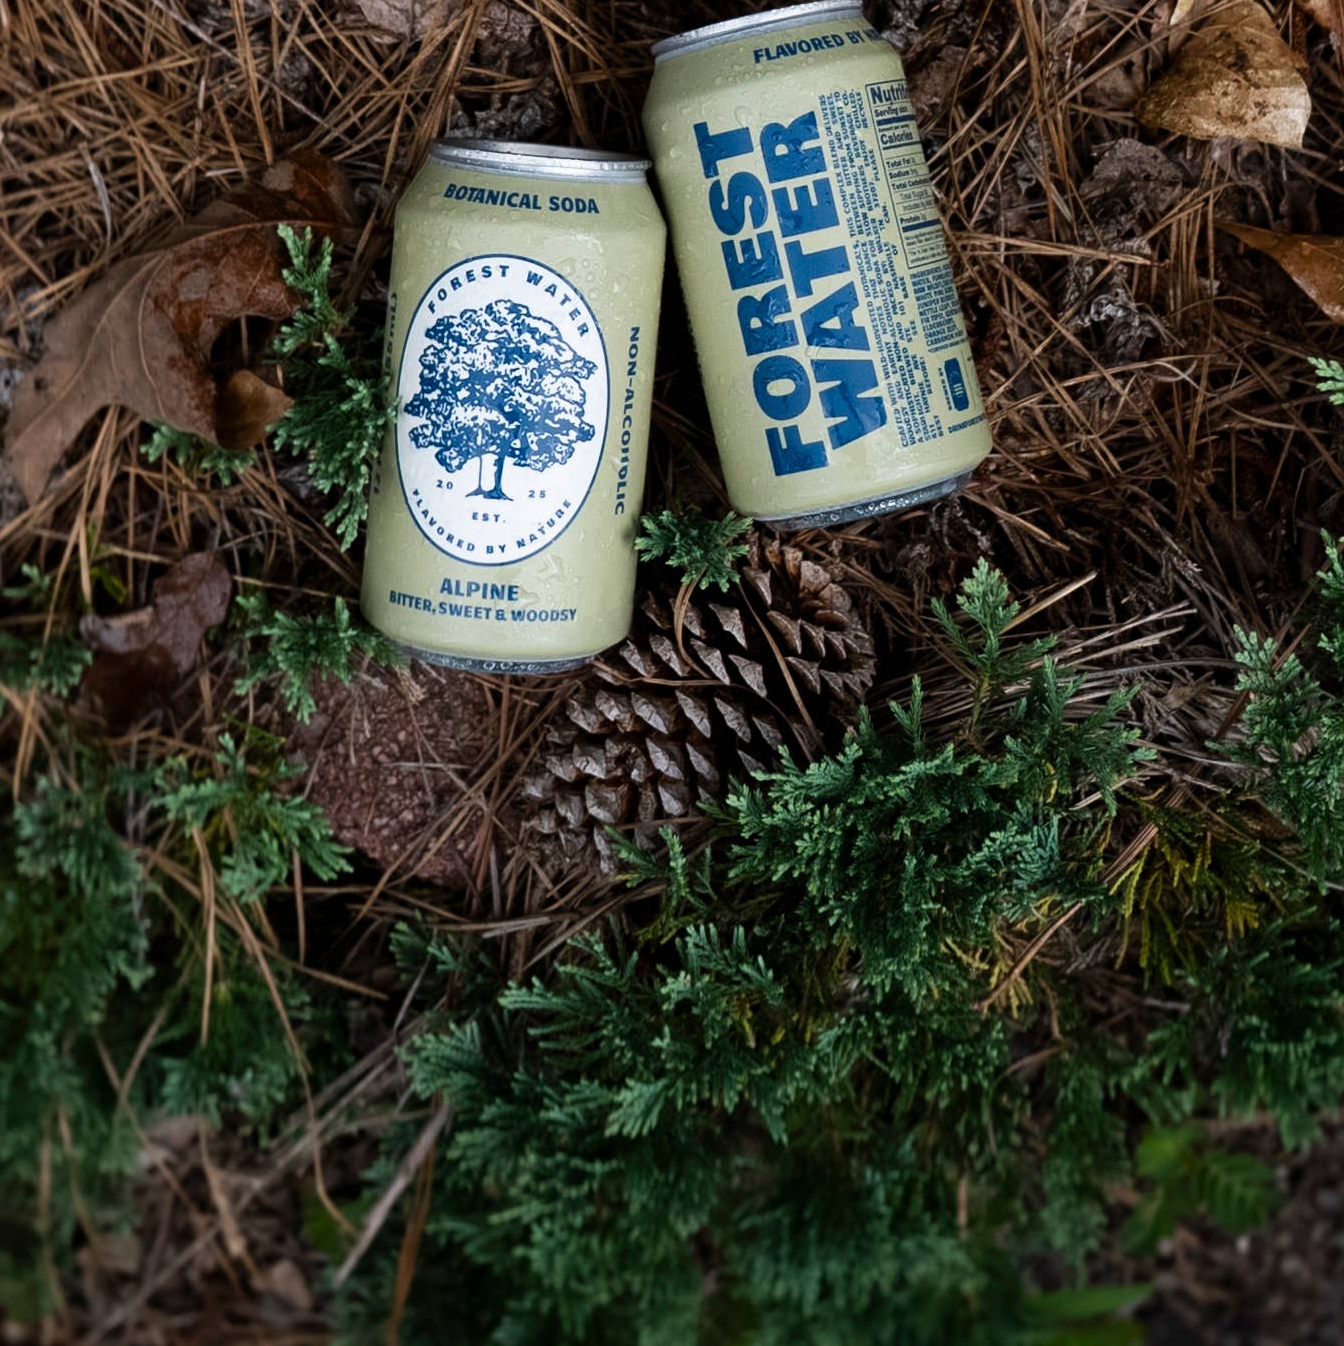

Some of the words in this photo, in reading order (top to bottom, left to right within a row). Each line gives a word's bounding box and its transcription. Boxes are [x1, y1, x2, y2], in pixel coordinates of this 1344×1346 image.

[753, 33, 844, 64] FLAVORED
[845, 29, 865, 44] BY
[834, 91, 841, 101] TO
[849, 89, 861, 128] CHILLED.
[856, 92, 868, 128] RECYCLE
[819, 95, 833, 136] DELIVERS
[837, 107, 849, 140] SUNSET
[874, 106, 898, 117] Serving
[835, 131, 843, 149] AND
[846, 113, 861, 158] BEVERAGE
[880, 130, 913, 145] Calories
[829, 140, 840, 168] BLEND
[845, 143, 855, 168] FROM
[859, 140, 870, 167] ENJOY
[869, 149, 880, 181] PLEASE
[886, 160, 902, 168] Total
[840, 157, 852, 186] BITTER
[889, 170, 910, 179] Sodium
[891, 182, 907, 190] Total
[443, 183, 542, 210] BOTANICAL
[549, 196, 600, 214] SODA
[835, 172, 851, 214] COMPLEX
[852, 172, 865, 209] SIPPING
[858, 165, 873, 211] BROTHERS
[849, 193, 864, 235] BETWEEN
[861, 212, 871, 236] SLOW
[878, 219, 885, 230] TN
[882, 201, 890, 223] CAN.
[900, 215, 920, 224] Protein
[847, 217, 856, 238] THIS
[871, 218, 883, 253] WALKER
[861, 241, 873, 271] DANCE
[868, 240, 877, 257] FOR
[891, 245, 898, 255] OF
[759, 111, 888, 450] WATER
[853, 240, 871, 298] BOTANICALS,
[873, 261, 883, 285] SODA
[884, 242, 899, 290] NASHVILLE
[427, 265, 509, 314] FOREST
[526, 271, 589, 338] WATER
[693, 121, 829, 476] FOREST
[869, 279, 879, 298] THAT
[886, 281, 898, 315] PACKED
[899, 277, 909, 298] BASE
[876, 306, 888, 334] NOTES
[898, 301, 906, 315] 101
[867, 301, 891, 379] WILD-HARVESTED
[880, 289, 903, 362] NON-ALCOHOLIC
[896, 322, 905, 340] AND
[885, 342, 898, 374] EARTHY
[902, 347, 916, 385] BREWED
[911, 355, 920, 370] AVE
[887, 383, 897, 405] WITH
[895, 381, 904, 399] AND
[899, 365, 921, 434] SOPHISTICATED
[918, 382, 930, 413] HAYNIE
[614, 326, 641, 516] NON-ALCOHOLIC
[894, 408, 909, 447] CRAFTED
[901, 407, 916, 445] WOODSY
[934, 415, 943, 437] BEST
[436, 479, 454, 490] 20
[528, 490, 546, 499] 25
[412, 489, 475, 551] FLAVORED
[486, 544, 506, 554] BY
[516, 499, 571, 549] NATURE
[472, 512, 506, 523] EST.
[440, 578, 520, 601] ALPINE
[389, 590, 436, 616] BITTER,
[438, 601, 492, 620] SWEET
[495, 609, 506, 621] &
[511, 608, 577, 622] WOODSY
